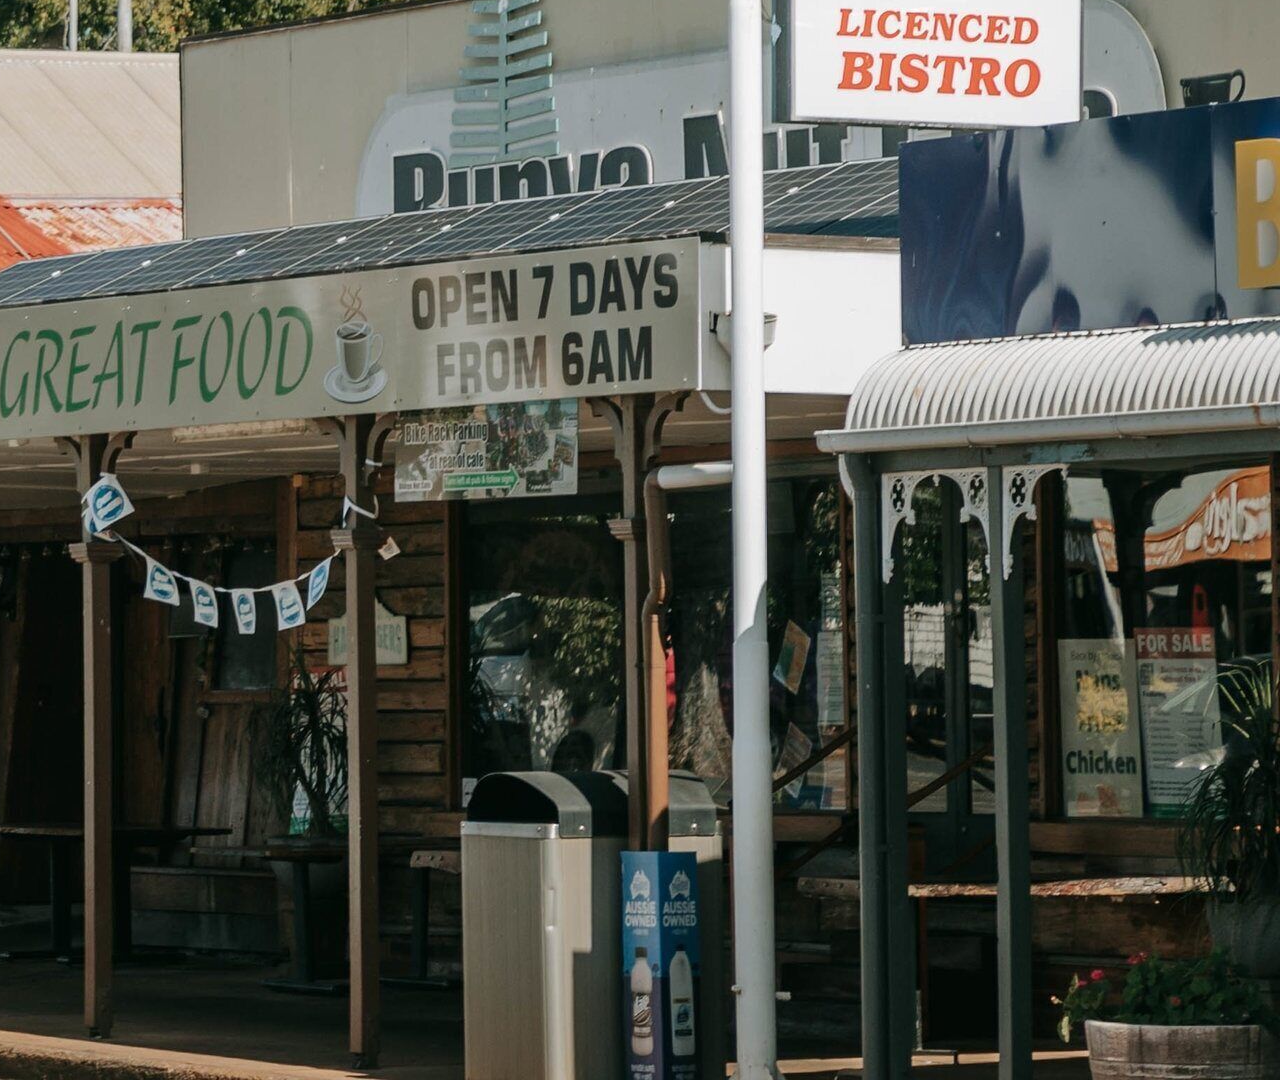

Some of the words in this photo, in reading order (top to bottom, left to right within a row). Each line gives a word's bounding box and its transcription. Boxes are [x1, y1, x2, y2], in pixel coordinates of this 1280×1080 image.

[836, 8, 1040, 45] LICENCED
[837, 52, 1041, 98] BISTRO
[412, 269, 518, 330] OPEN
[532, 265, 554, 319] 7
[570, 253, 678, 316] DAYS
[0, 319, 161, 419] GREAT
[169, 306, 313, 406] FOOD
[437, 335, 546, 395] FROM
[562, 326, 652, 385] 6AM
[405, 423, 426, 443] Bike
[428, 423, 450, 442] Rack
[453, 421, 488, 441] Parking
[466, 451, 484, 467] cafe
[1137, 634, 1168, 652] FOR
[1172, 633, 1212, 652] SALE
[1066, 750, 1136, 774] Chicken
[625, 899, 655, 914] AUSSIE
[663, 900, 696, 915] AUSSIE
[625, 914, 656, 927] OWNED
[662, 915, 697, 927] OWNED
